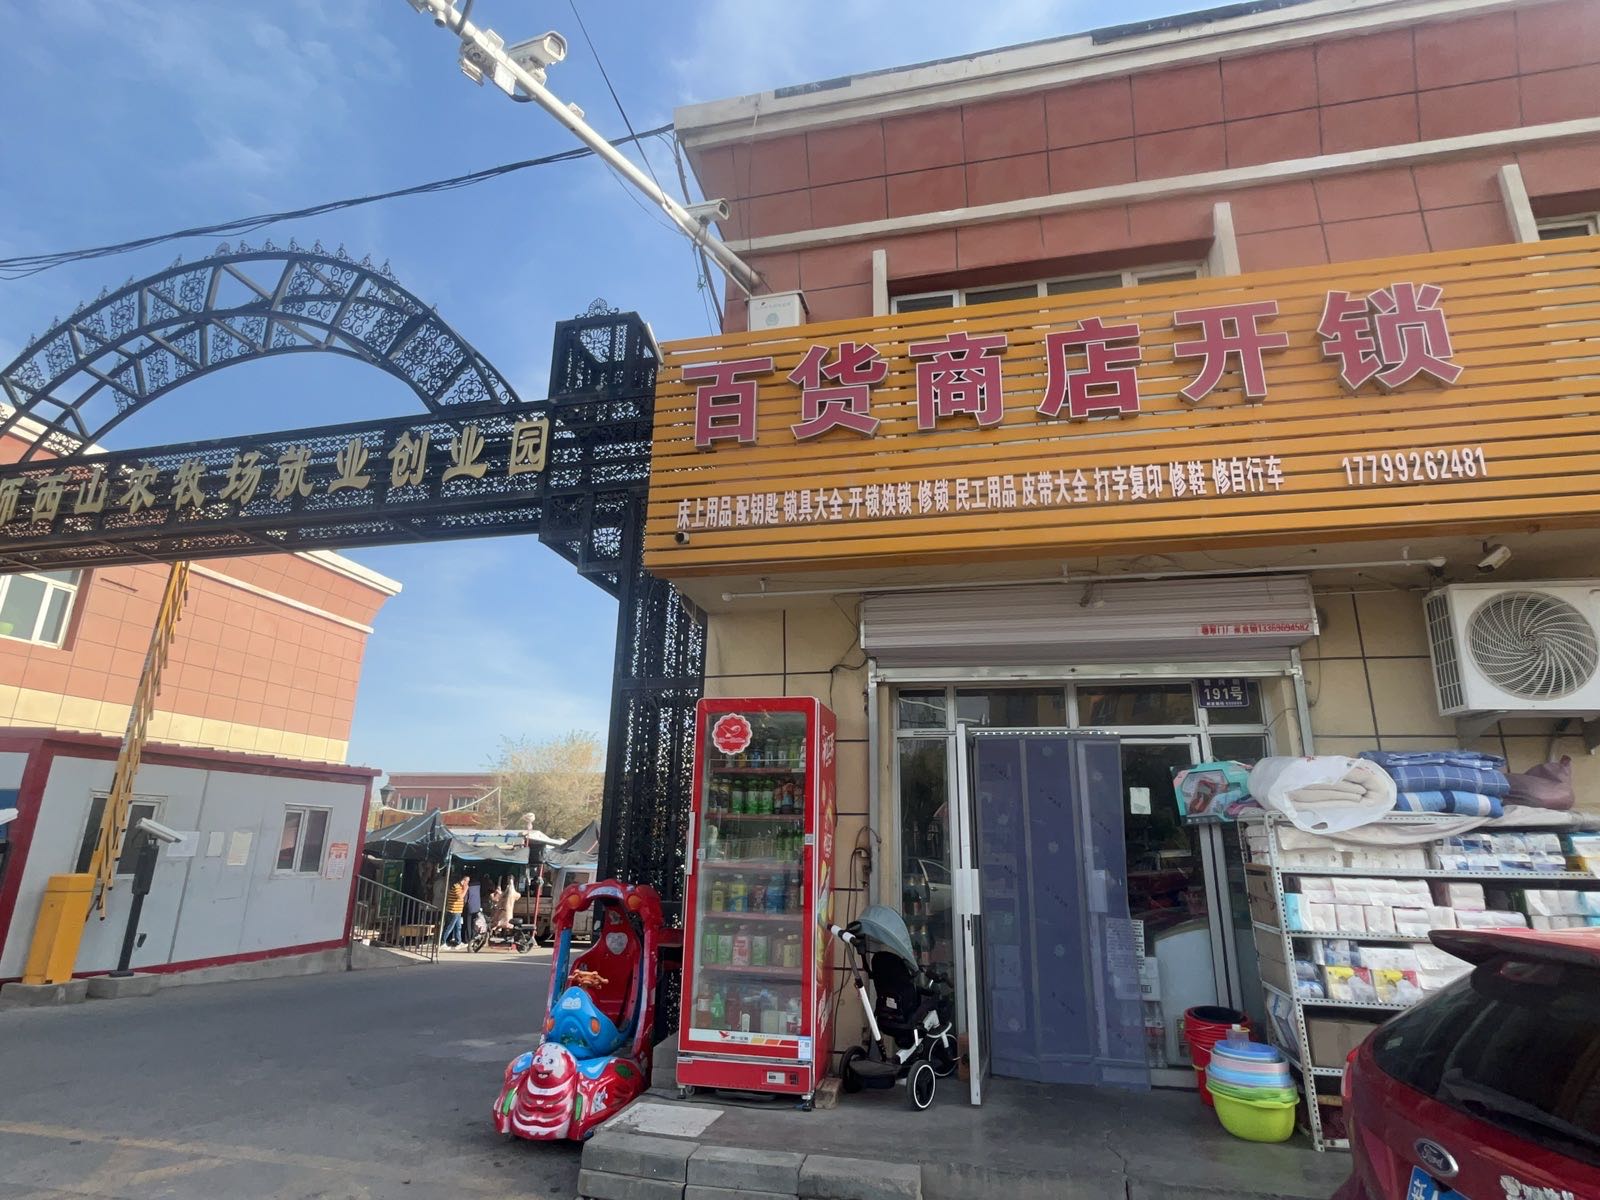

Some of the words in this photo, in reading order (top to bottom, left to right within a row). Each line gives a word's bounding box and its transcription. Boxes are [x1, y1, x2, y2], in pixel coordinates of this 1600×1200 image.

[682, 282, 1464, 448] 百货商店开锁
[676, 496, 732, 530] 床上用品
[735, 493, 779, 526] 配钥匙
[784, 488, 843, 522] 锁具大全
[849, 482, 912, 518] 开锁换锁
[918, 479, 949, 513] 修锁
[955, 475, 1016, 511] 民工用品
[1021, 469, 1088, 506] 皮带大全
[1094, 464, 1163, 502] 打字复印
[1169, 460, 1207, 497] 修鞋
[1211, 455, 1285, 494] 修自行车
[1341, 447, 1488, 485] 17799262481
[1203, 685, 1244, 700] 191号
